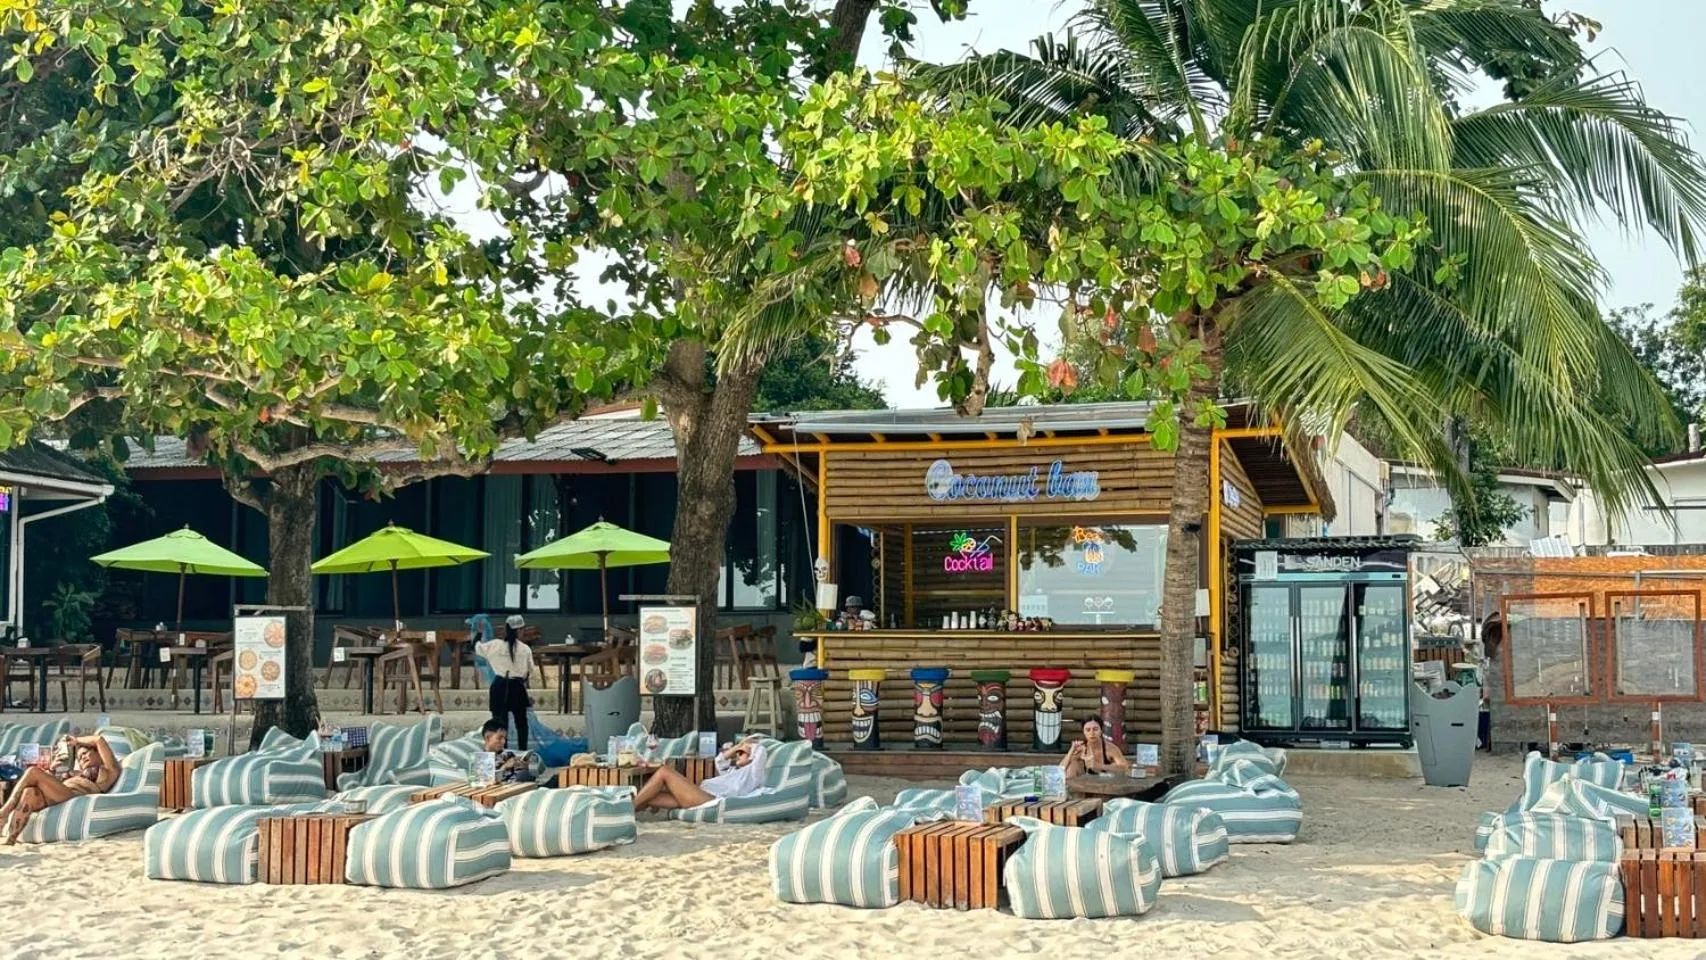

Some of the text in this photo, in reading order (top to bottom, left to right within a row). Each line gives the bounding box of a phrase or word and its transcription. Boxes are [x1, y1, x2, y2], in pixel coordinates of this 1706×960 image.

[925, 459, 1040, 499] Coconut
[944, 553, 993, 571] Cocktail
[1306, 556, 1361, 569] SANDEN
